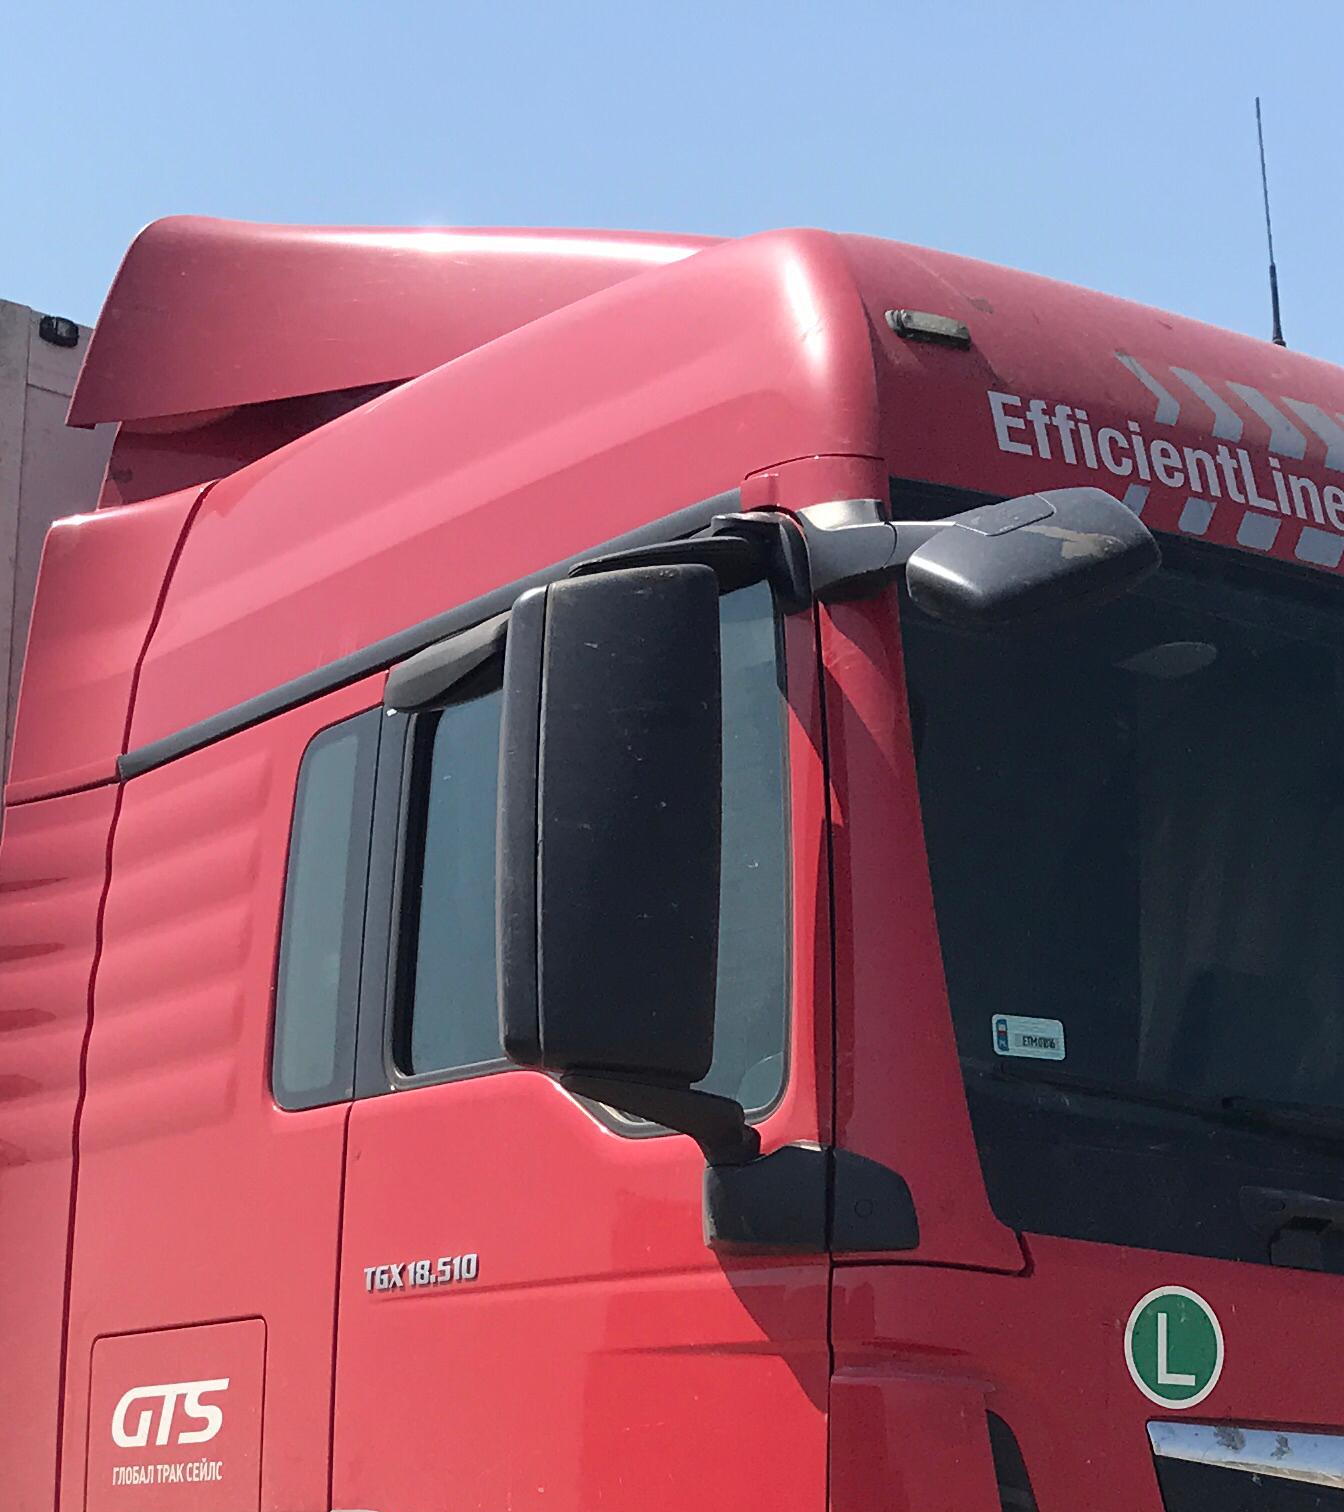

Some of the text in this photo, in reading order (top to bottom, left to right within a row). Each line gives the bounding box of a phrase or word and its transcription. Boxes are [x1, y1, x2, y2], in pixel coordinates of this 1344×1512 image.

[364, 1253, 478, 1291] TGX 18.510
[1157, 1311, 1196, 1386] L
[111, 1377, 230, 1448] GTS
[112, 1457, 223, 1486] ГЛОБАЛ ТРАК СЕЙЛС
